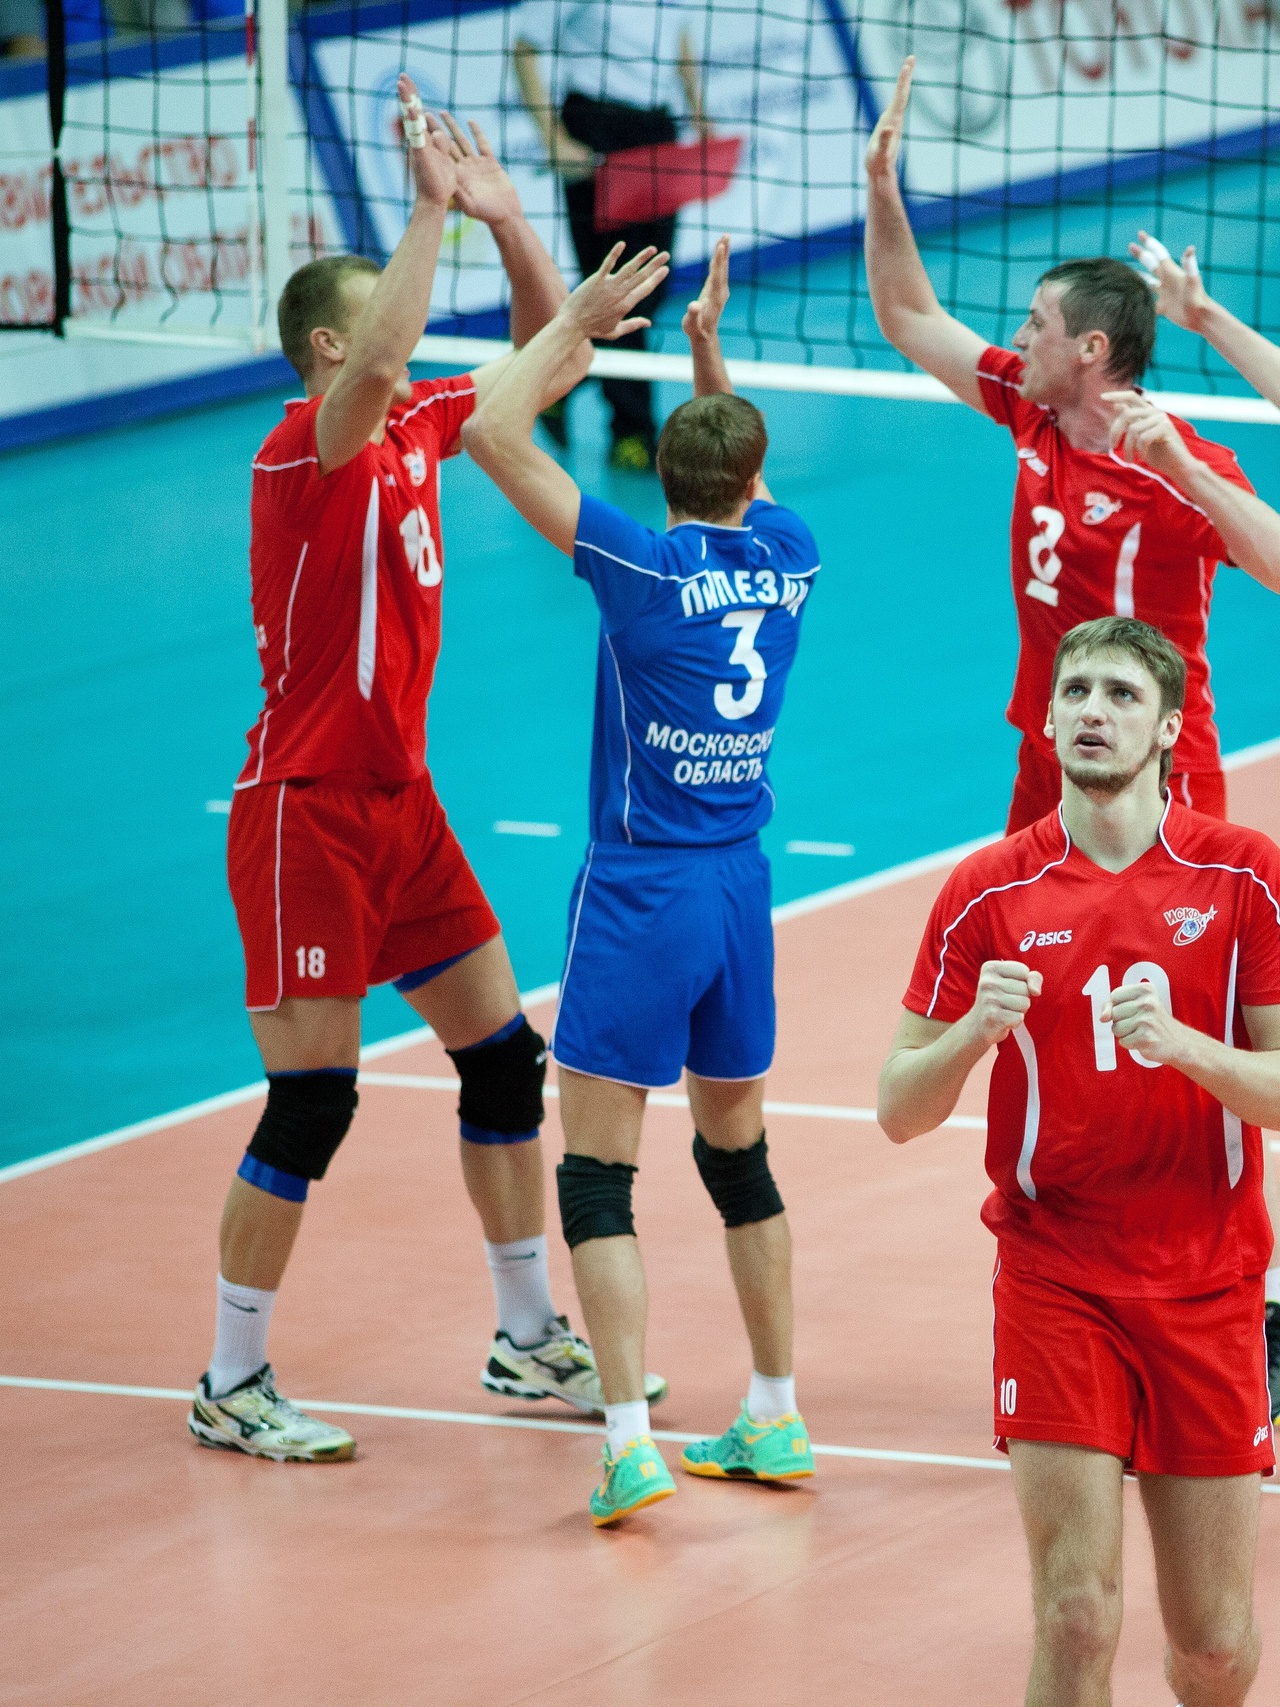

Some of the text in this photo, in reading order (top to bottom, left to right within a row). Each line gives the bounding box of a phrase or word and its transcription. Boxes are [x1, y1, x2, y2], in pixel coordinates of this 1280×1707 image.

[713, 609, 767, 720] 3
[674, 758, 763, 785] ОБЛАСТЬ
[295, 945, 326, 979] 18
[1000, 1377, 1017, 1415] 10
